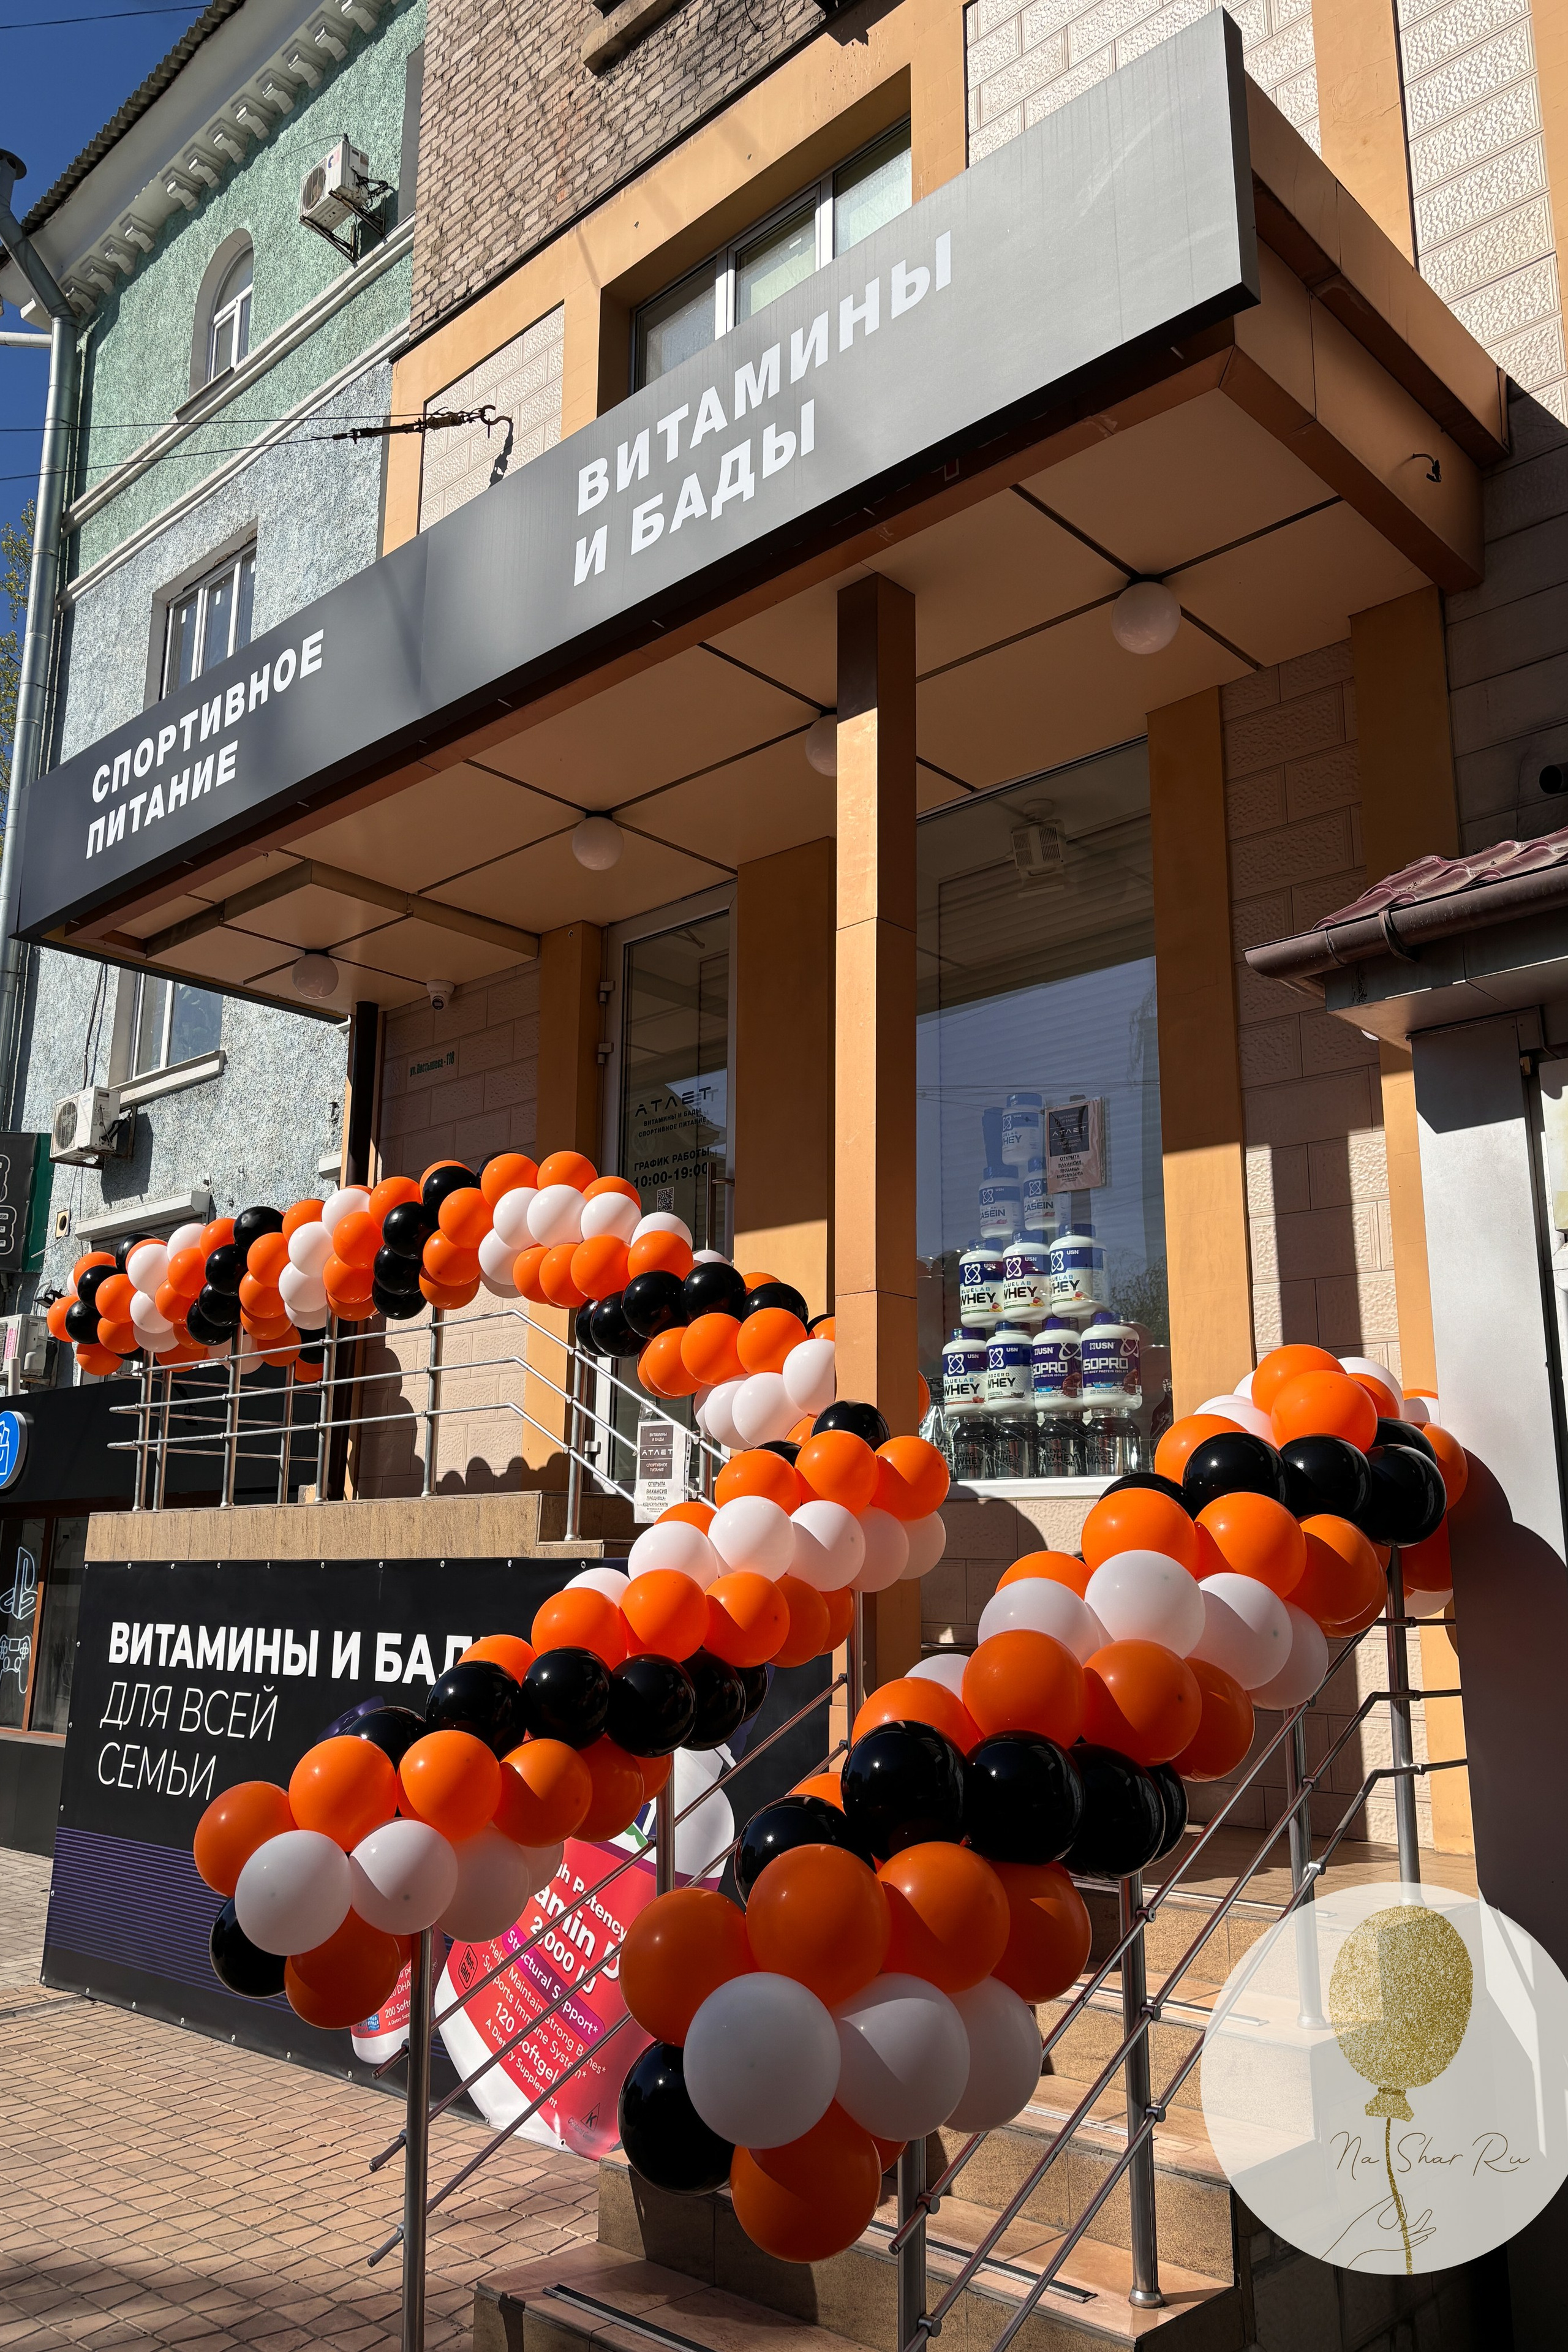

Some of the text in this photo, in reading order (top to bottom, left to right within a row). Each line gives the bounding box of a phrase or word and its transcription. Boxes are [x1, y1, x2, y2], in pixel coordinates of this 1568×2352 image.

[578, 229, 951, 516] ВИТАМИНЫ
[573, 398, 815, 587] И БАДЫ
[92, 628, 324, 803] СПОРТИВНОЕ
[86, 740, 238, 859] ПИТАНИЕ
[635, 1086, 711, 1117] АТЛЕТ
[638, 1117, 706, 1137] СПОРТИВНОЕ ПИТАНИЕ
[644, 1114, 676, 1126] ВИТАМИНЫ
[684, 1108, 701, 1117] БАДЫ
[1052, 1126, 1086, 1136] АТЛЕТ
[634, 1147, 709, 1171] ГРАФИК РАБОТЫ
[633, 1163, 707, 1189] 10:00-19:00
[961, 1292, 996, 1306] WHEY
[944, 1383, 980, 1396] WHEY
[108, 1622, 319, 1677] ВИТАМИНЫ
[331, 1630, 361, 1680] И
[99, 1681, 278, 1742] ДЛЯ ВСЕЙ
[98, 1741, 217, 1801] СЕМЬИ
[460, 1962, 470, 1983] GMO
[385, 2007, 396, 2019] 200
[391, 2016, 402, 2026] Dietary
[495, 2002, 514, 2033] 120
[552, 1985, 598, 2035] Spport
[485, 2018, 491, 2029] A
[576, 2045, 606, 2075] Bnes
[586, 2112, 597, 2128] K
